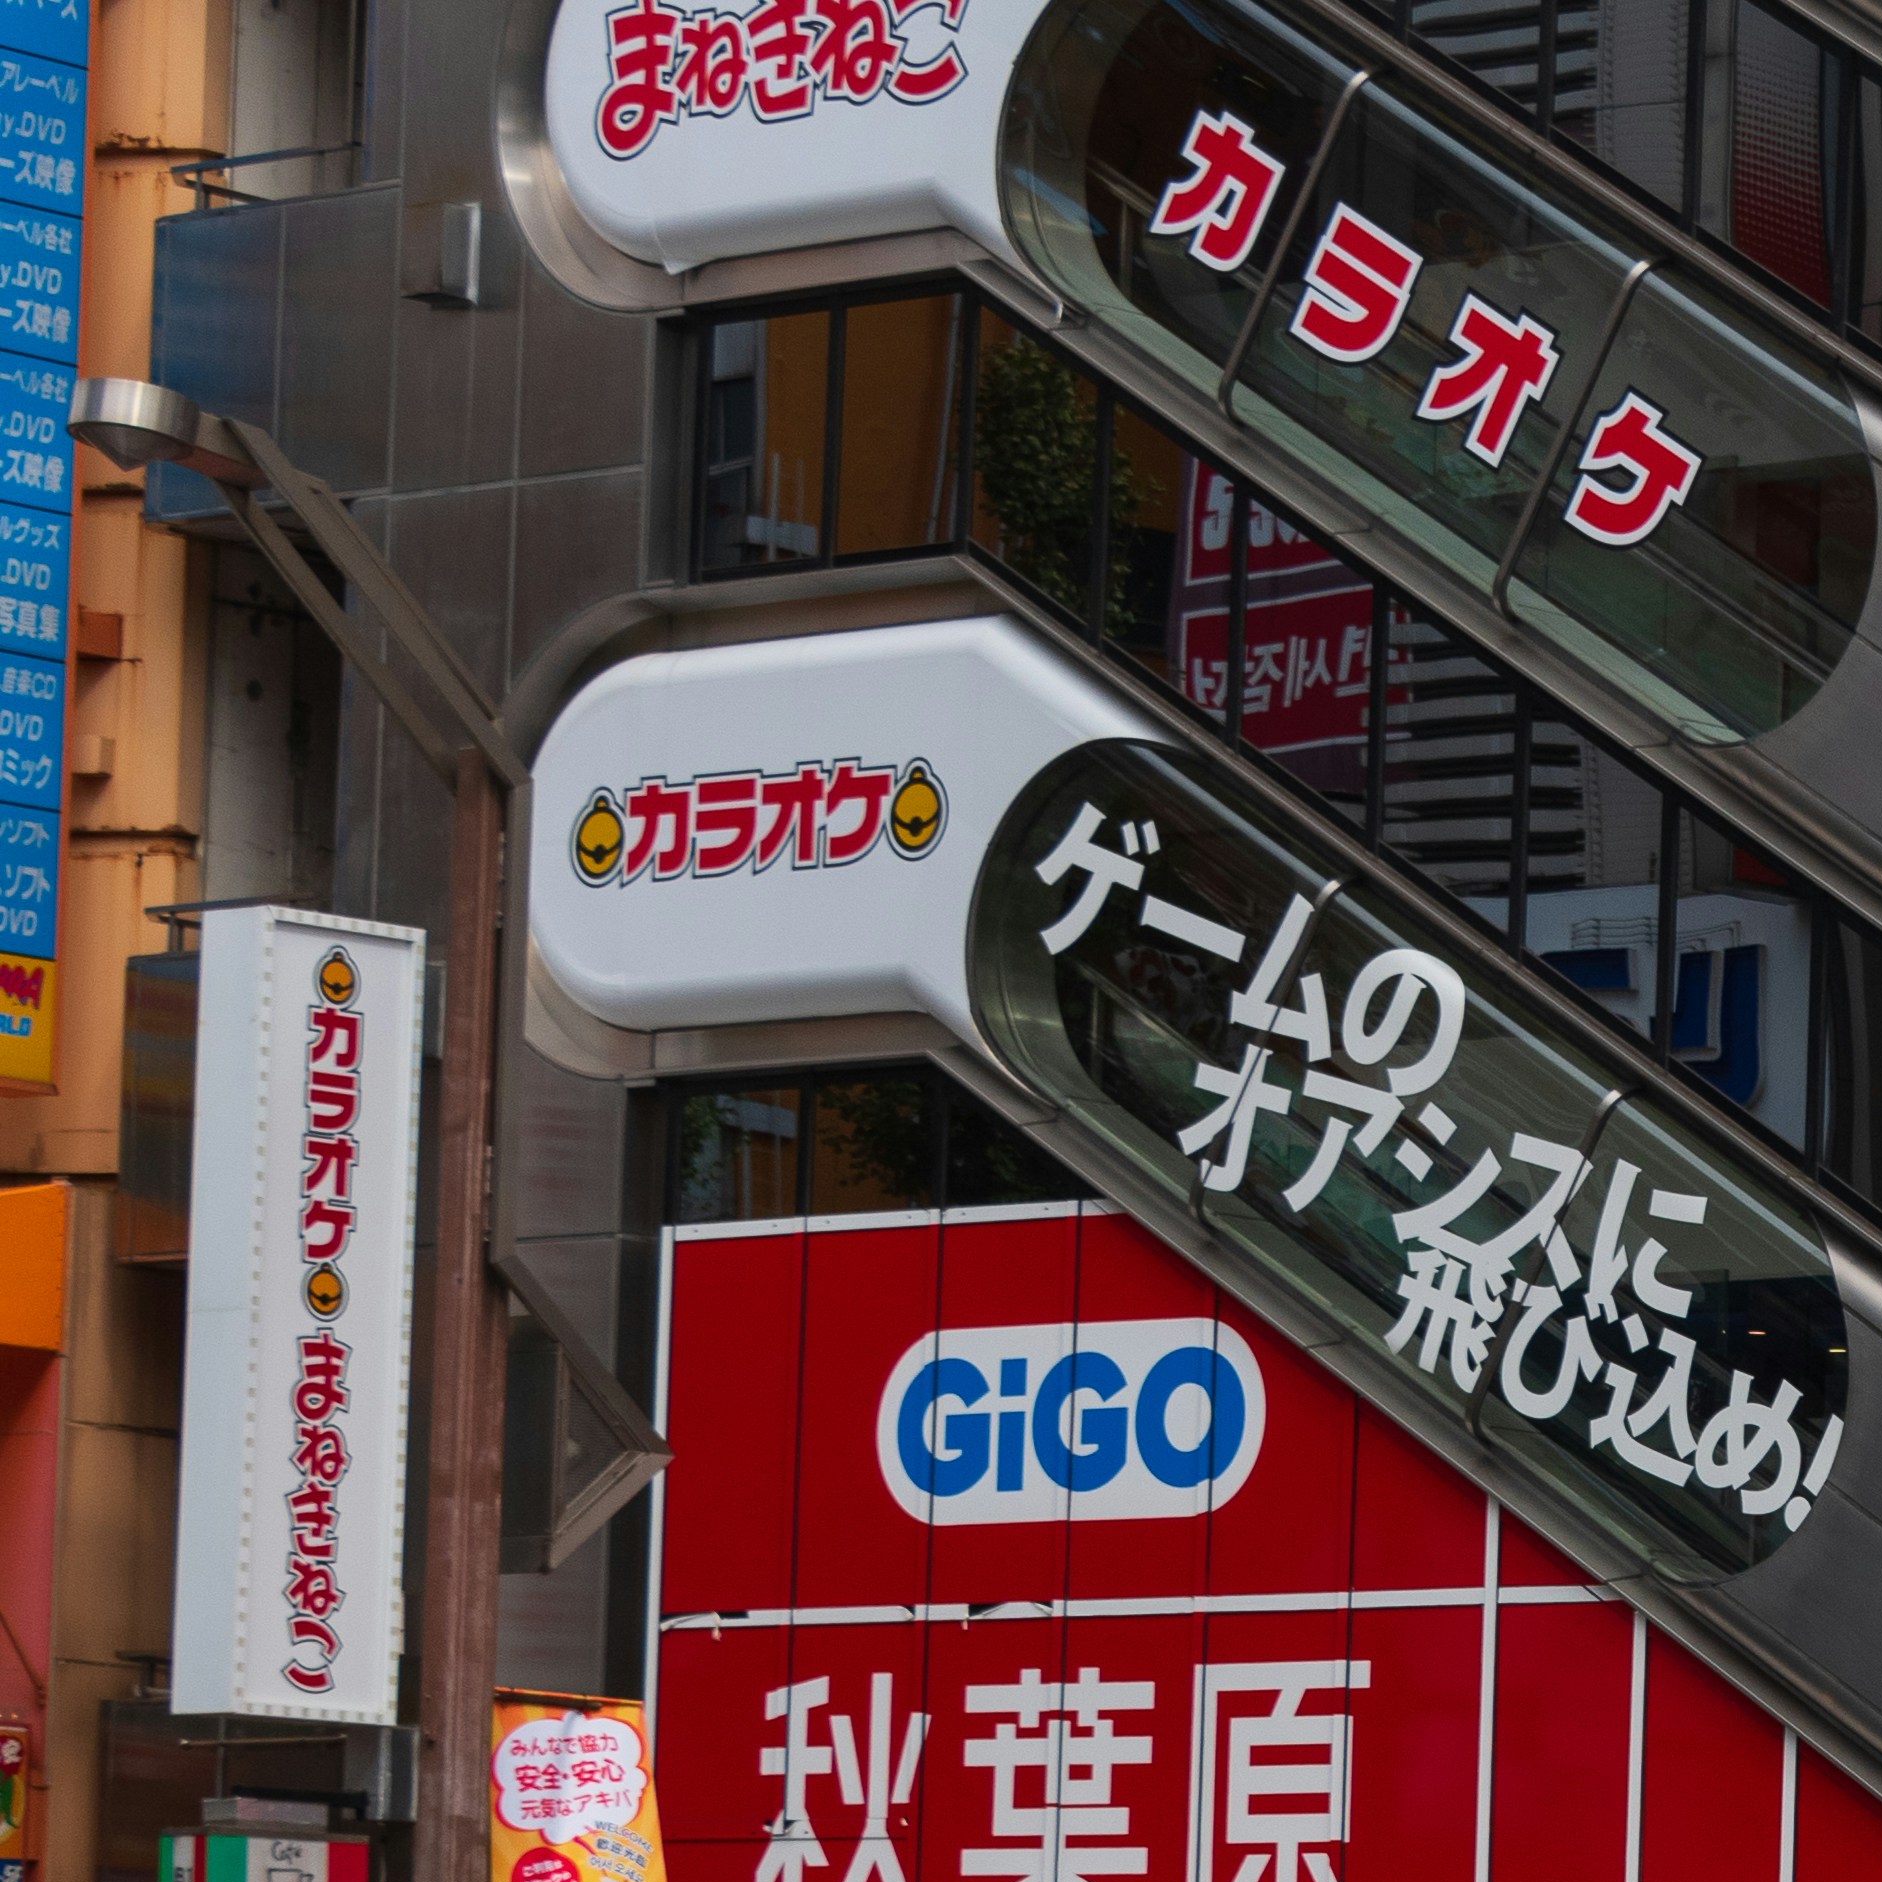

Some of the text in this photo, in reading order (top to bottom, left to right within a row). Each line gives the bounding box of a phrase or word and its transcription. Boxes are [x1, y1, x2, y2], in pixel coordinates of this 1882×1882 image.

[1147, 107, 1703, 547] カラオケ
[0, 450, 63, 493] ズ映像
[620, 756, 895, 885] カラオケ
[1036, 801, 1467, 1095] ゲームの
[300, 1005, 363, 1265] カラオケ
[282, 1326, 353, 1696] まねきねこ
[515, 1758, 625, 1792] 安全・安心
[521, 1789, 633, 1820] 元気なアキバ
